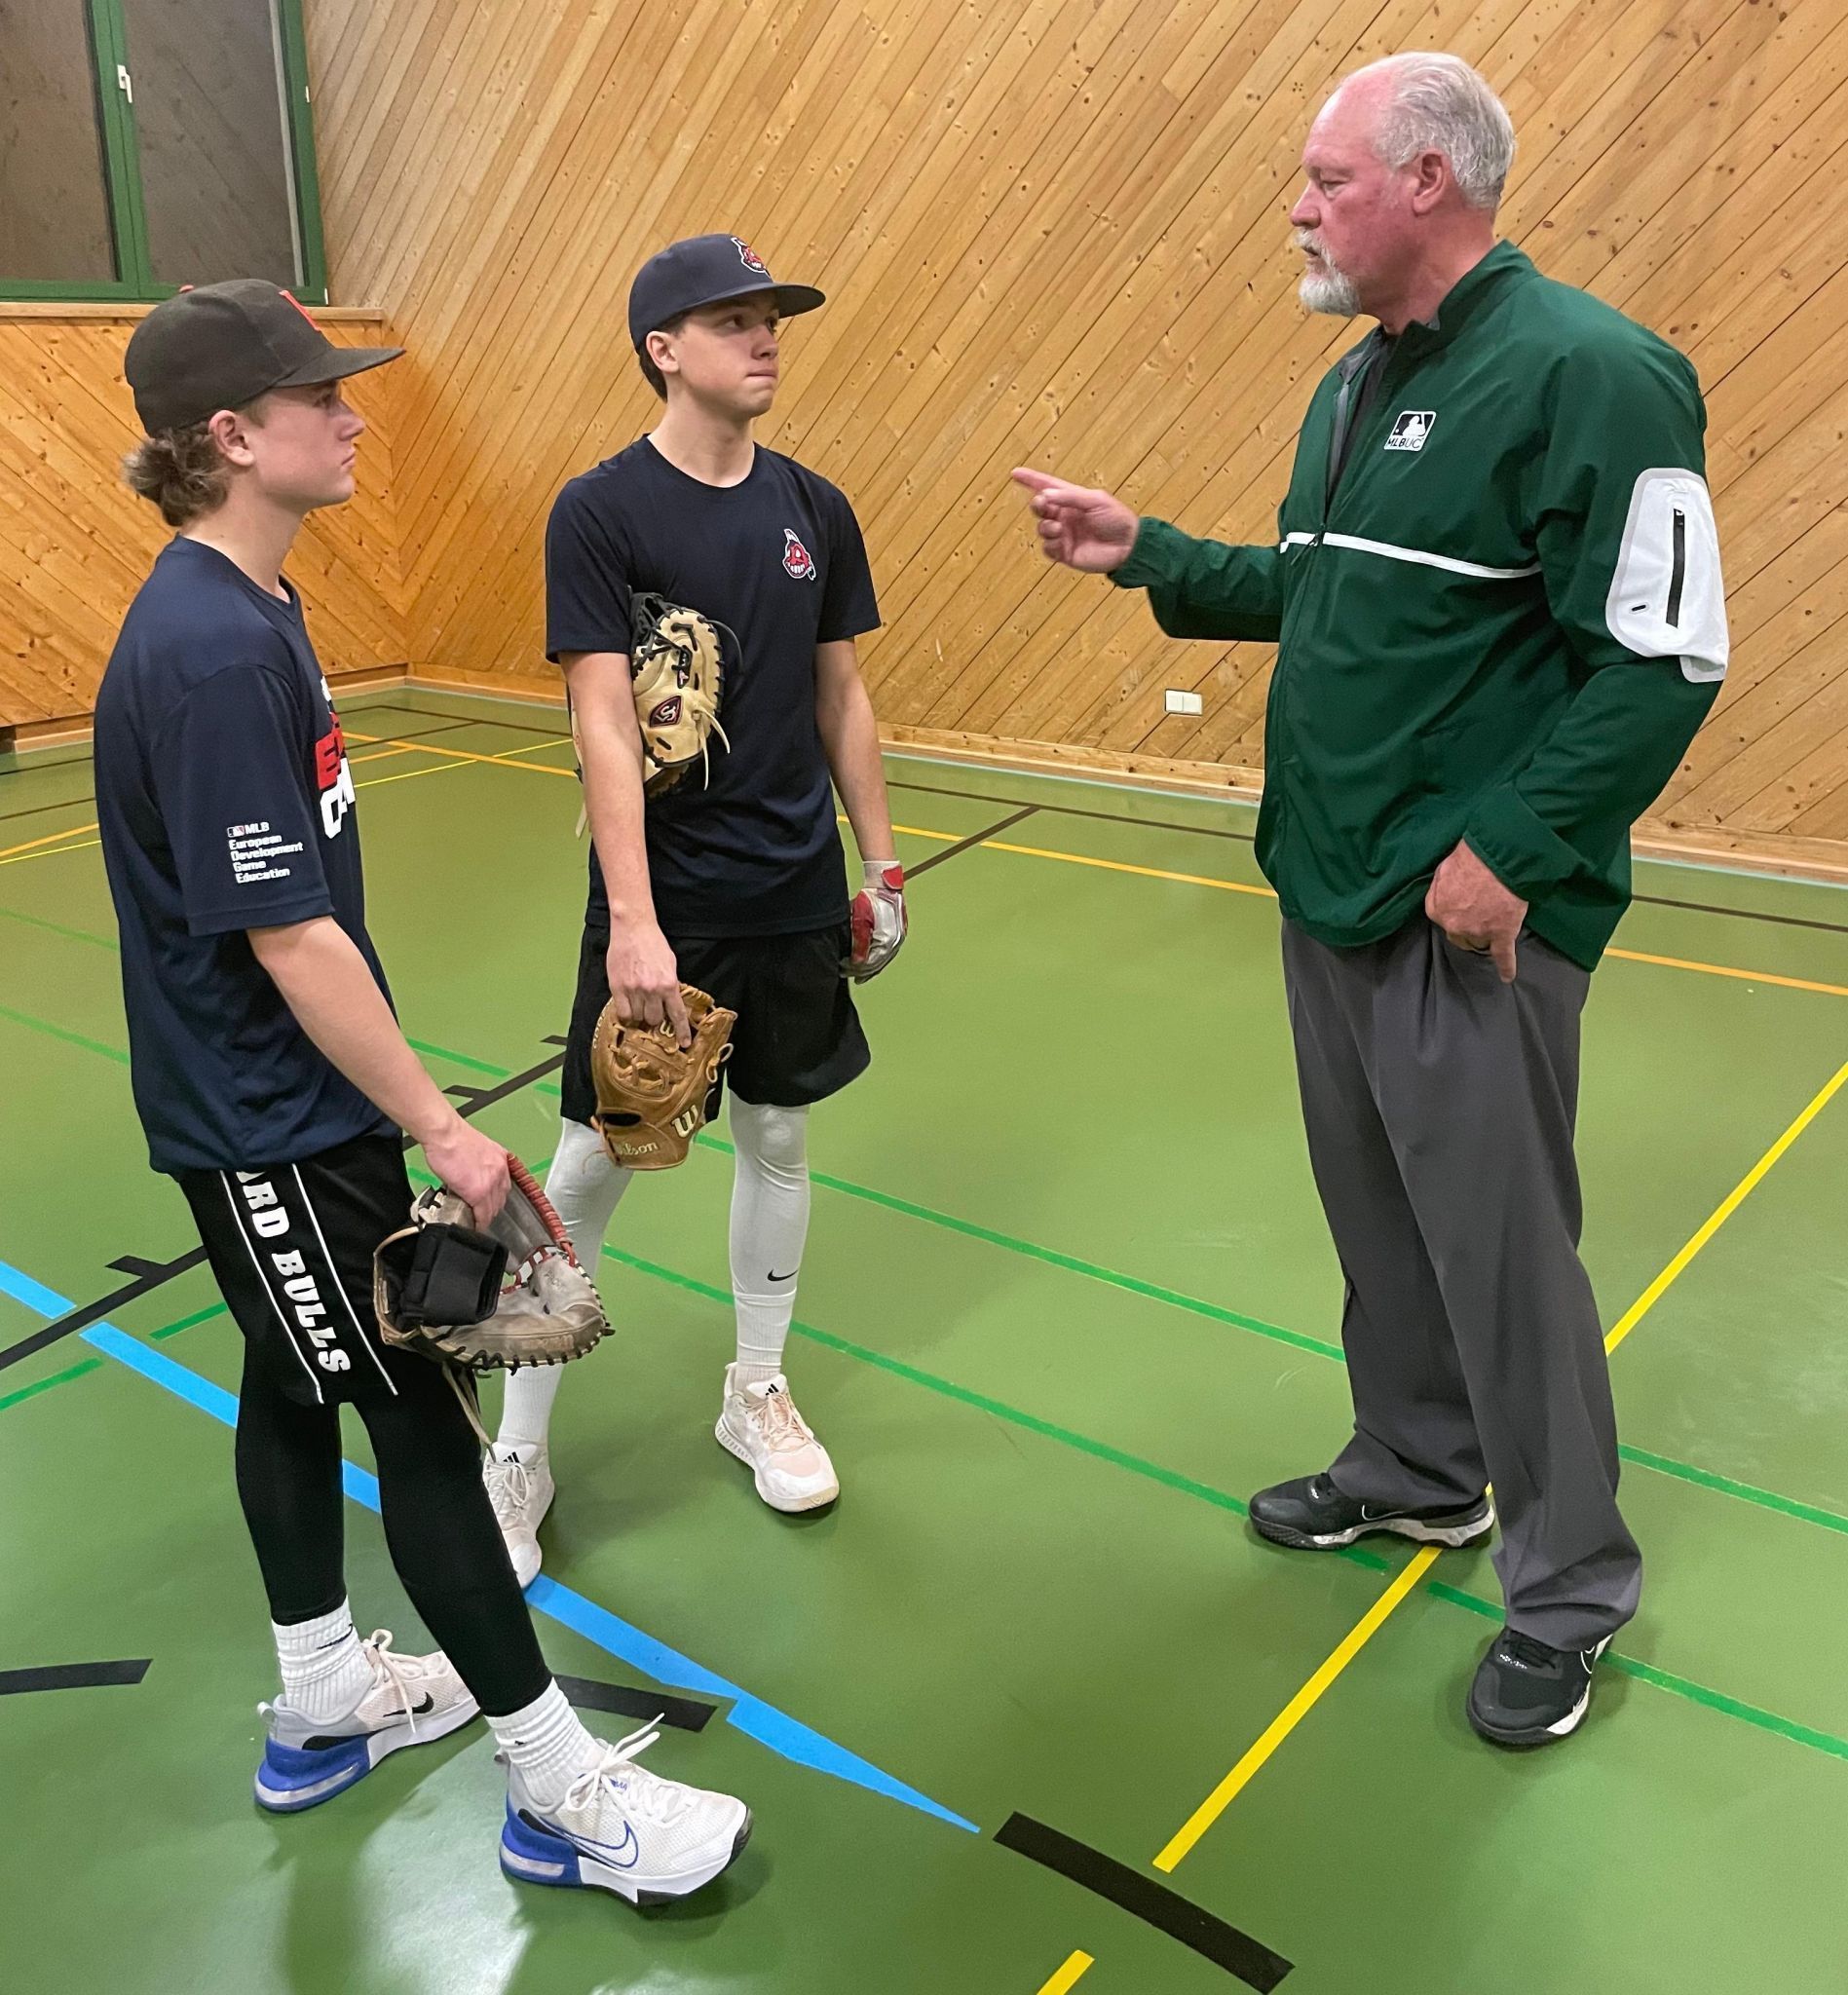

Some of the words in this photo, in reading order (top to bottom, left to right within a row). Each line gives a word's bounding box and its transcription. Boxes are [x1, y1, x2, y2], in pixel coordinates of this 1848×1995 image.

[245, 821, 270, 834] MLB
[229, 835, 283, 850] European
[230, 842, 304, 862] Development
[233, 860, 267, 873] Game
[235, 868, 291, 884] Education
[271, 1249, 352, 1373] BULLS
